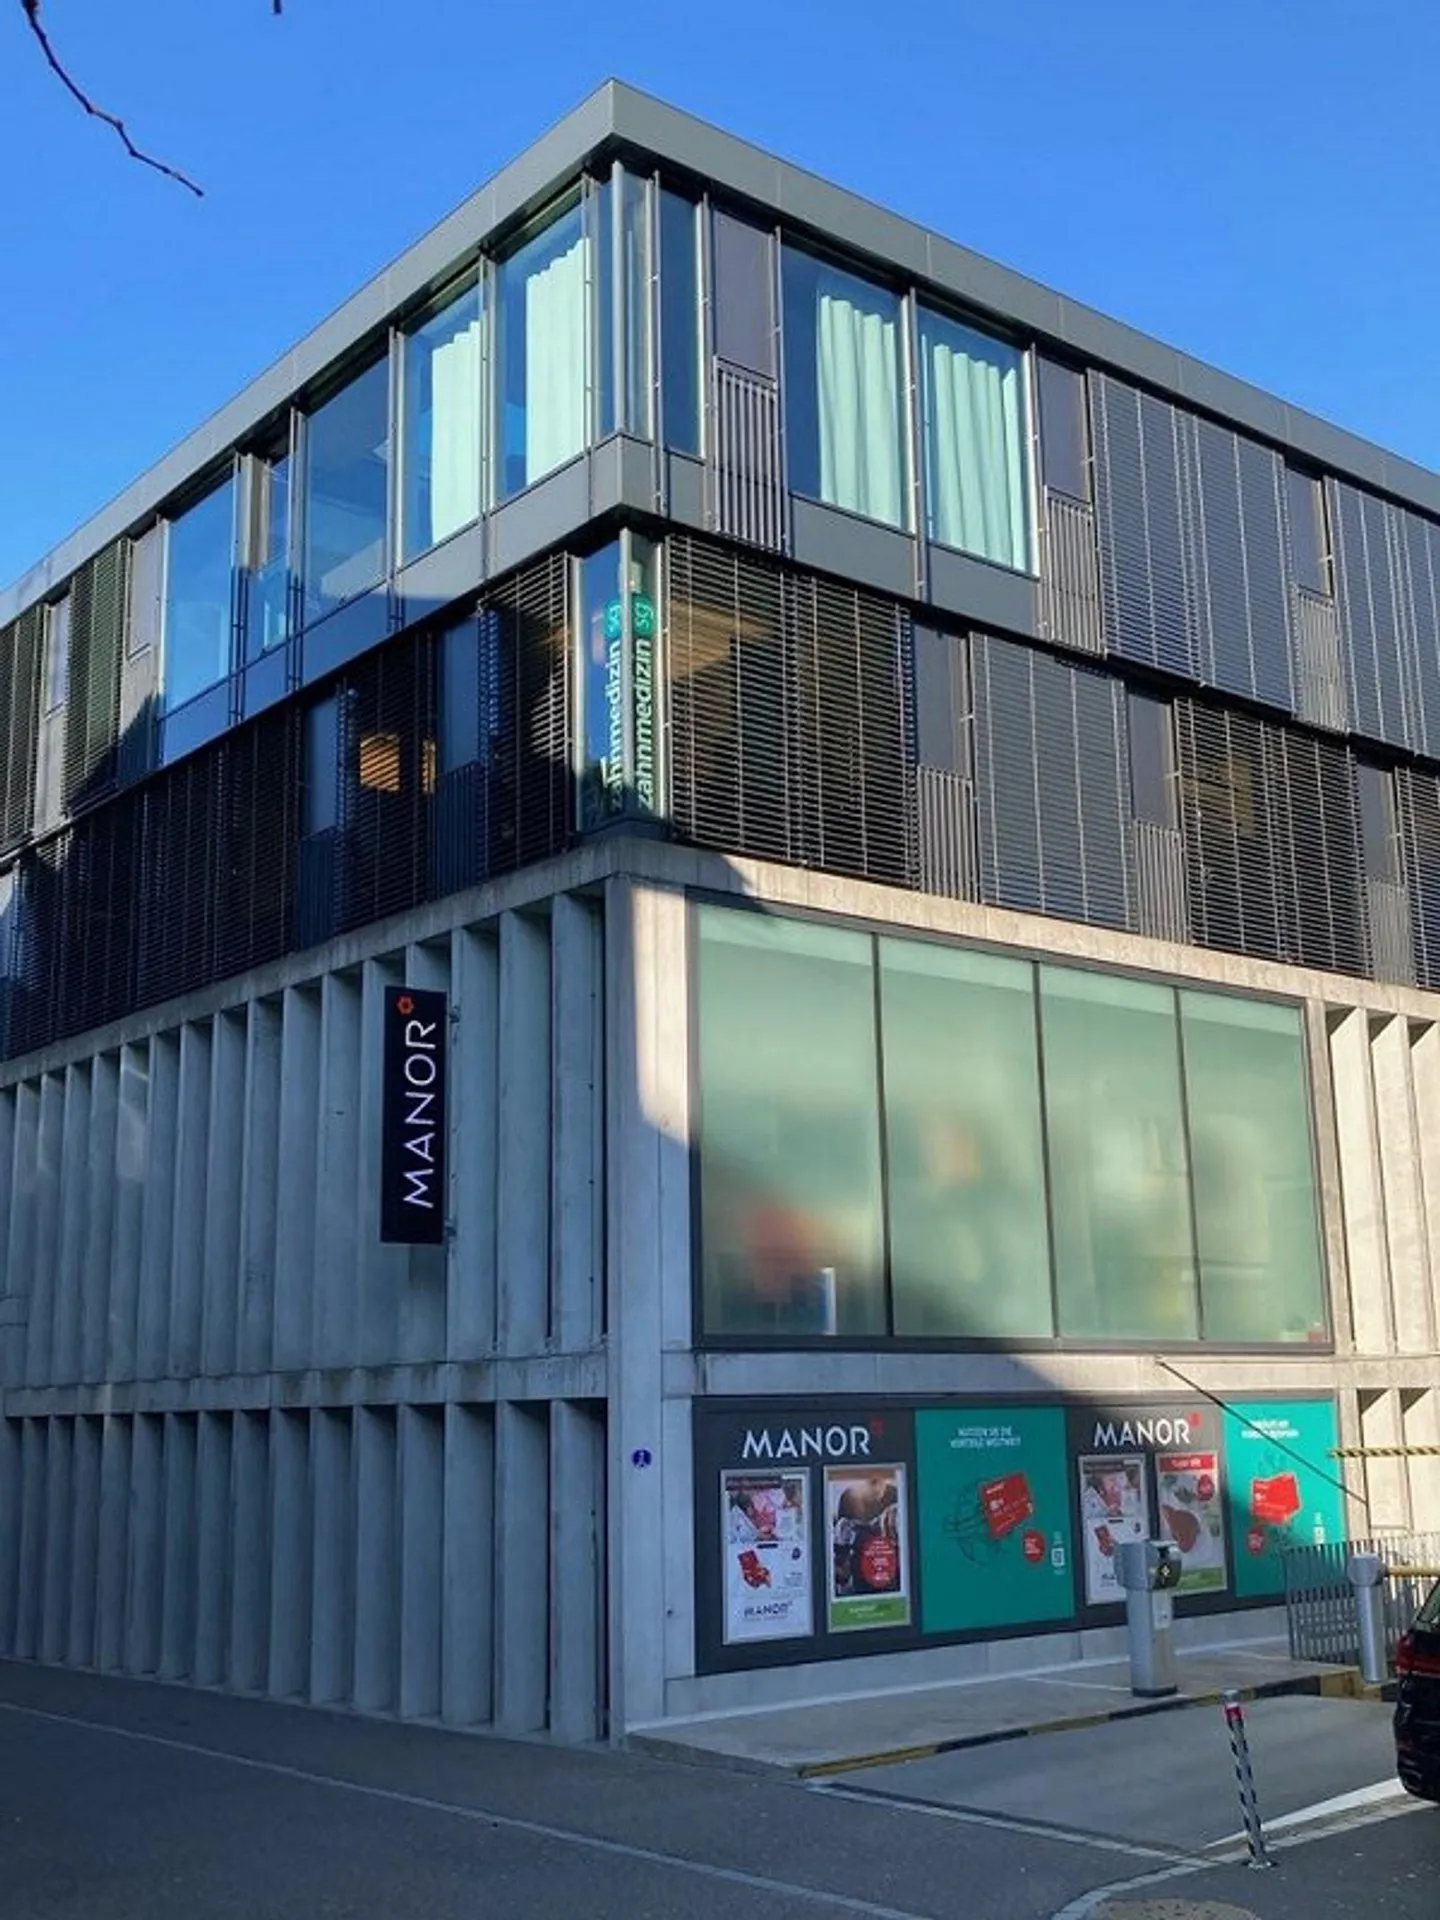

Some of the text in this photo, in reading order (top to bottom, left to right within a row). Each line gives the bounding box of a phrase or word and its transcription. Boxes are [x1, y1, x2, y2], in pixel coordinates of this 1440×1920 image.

[636, 640, 654, 811] zahnmedizin
[404, 1020, 437, 1208] MANOR
[741, 1425, 870, 1459] MANOR
[1093, 1418, 1191, 1447] MANOR
